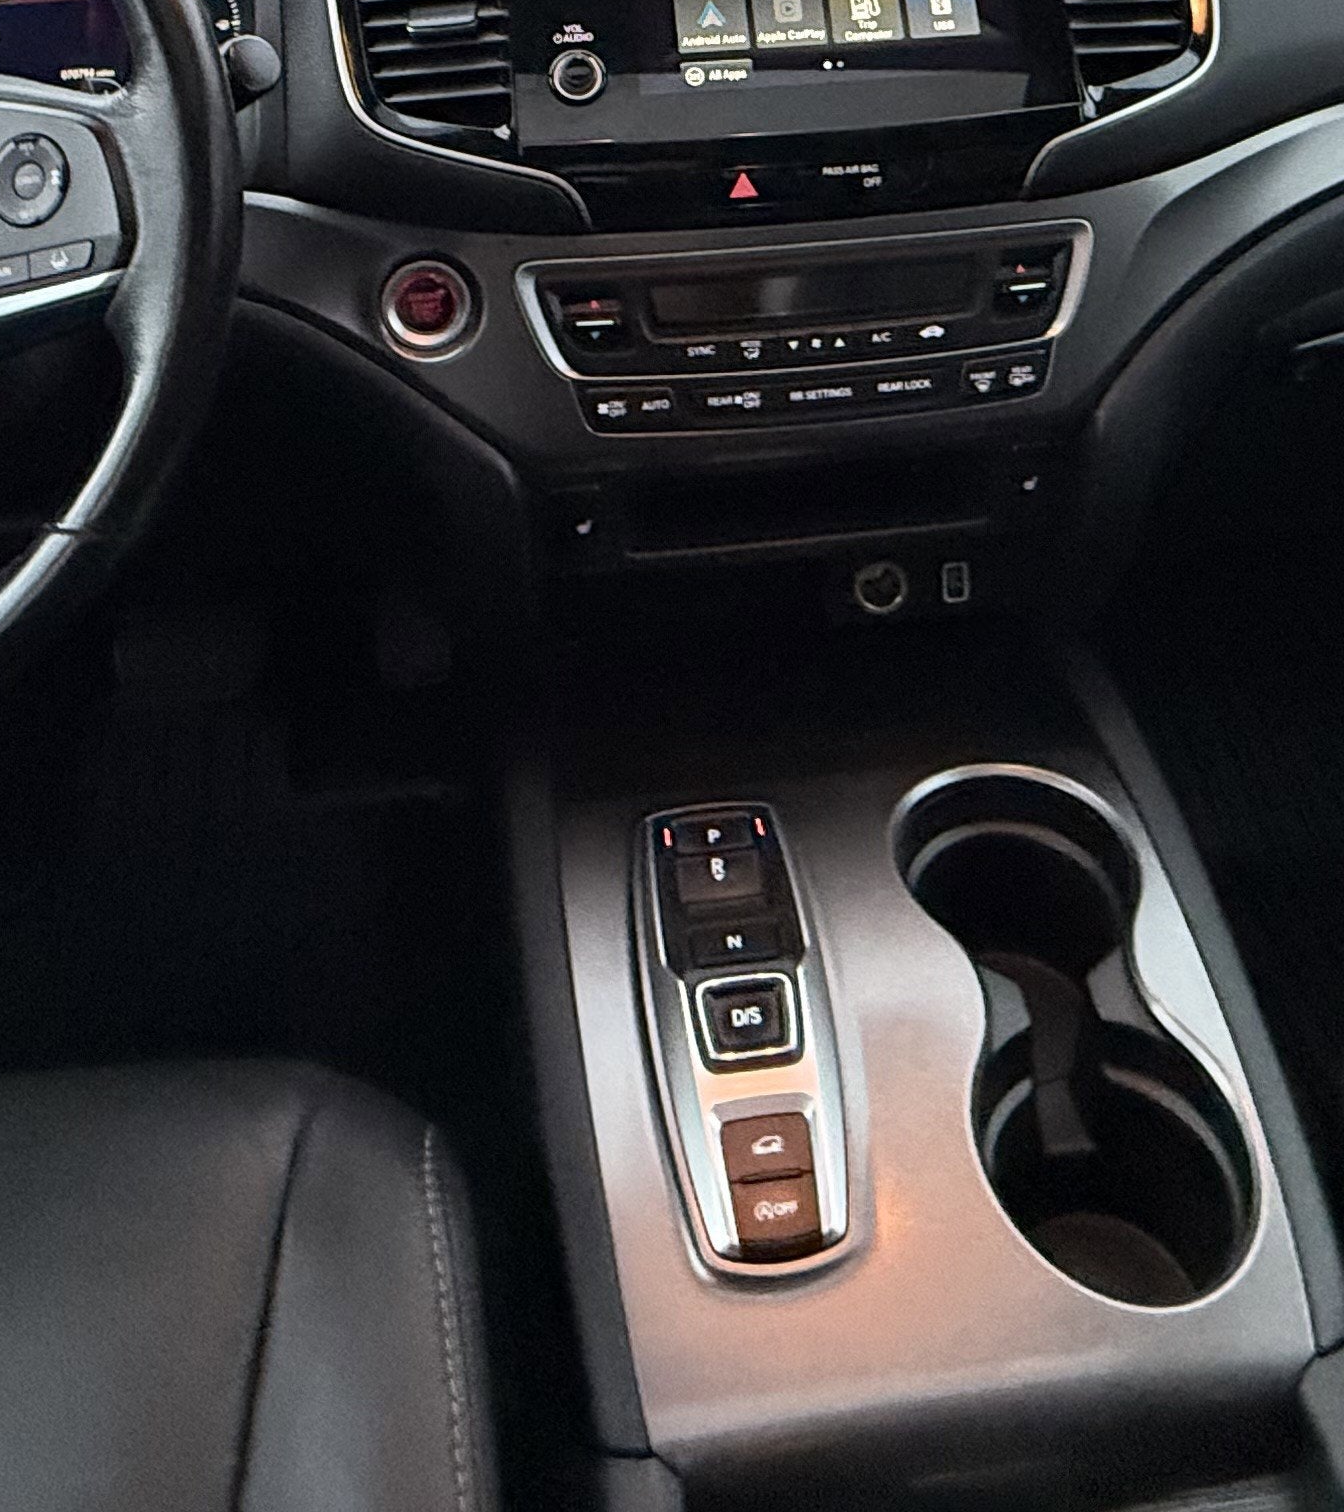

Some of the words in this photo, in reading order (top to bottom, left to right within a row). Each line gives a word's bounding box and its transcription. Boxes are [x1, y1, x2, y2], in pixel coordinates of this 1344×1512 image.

[681, 34, 721, 48] Android
[722, 34, 747, 44] Auto
[756, 31, 787, 44] Apple
[787, 28, 826, 40] CarPlay
[862, 175, 883, 188] OFF
[686, 344, 717, 358] SYNC
[706, 828, 721, 844] P
[726, 934, 743, 950] N
[730, 1006, 763, 1028] D/S
